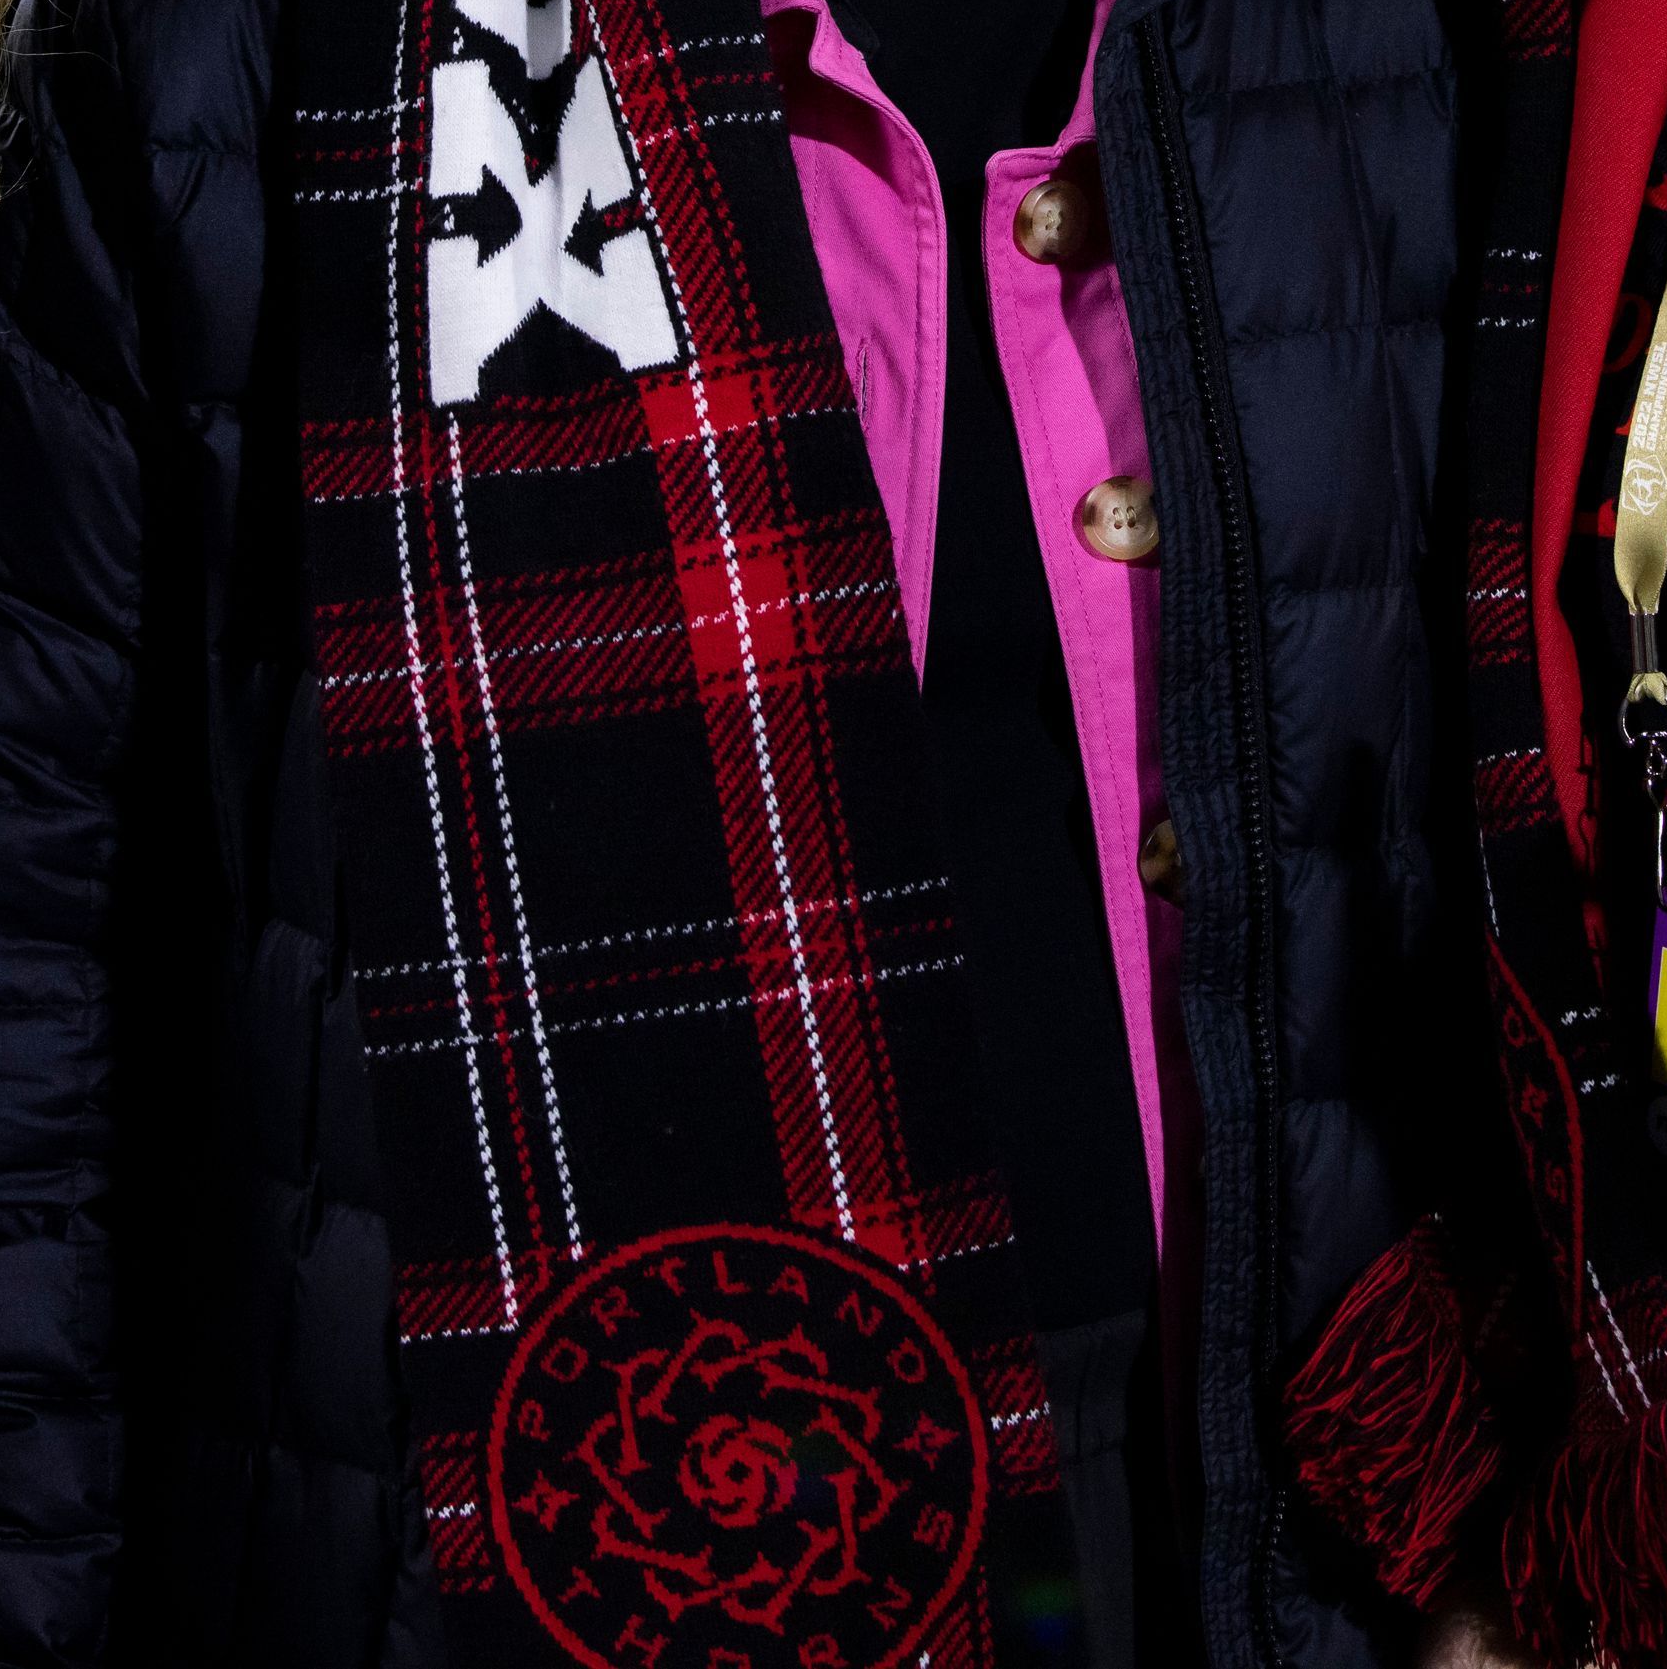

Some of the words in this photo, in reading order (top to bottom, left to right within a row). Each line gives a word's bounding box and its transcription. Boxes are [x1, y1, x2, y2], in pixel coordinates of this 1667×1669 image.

[1633, 401, 1652, 449] 2022
[1643, 341, 1667, 396] NWSL
[519, 1250, 928, 1440] PORTLAND
